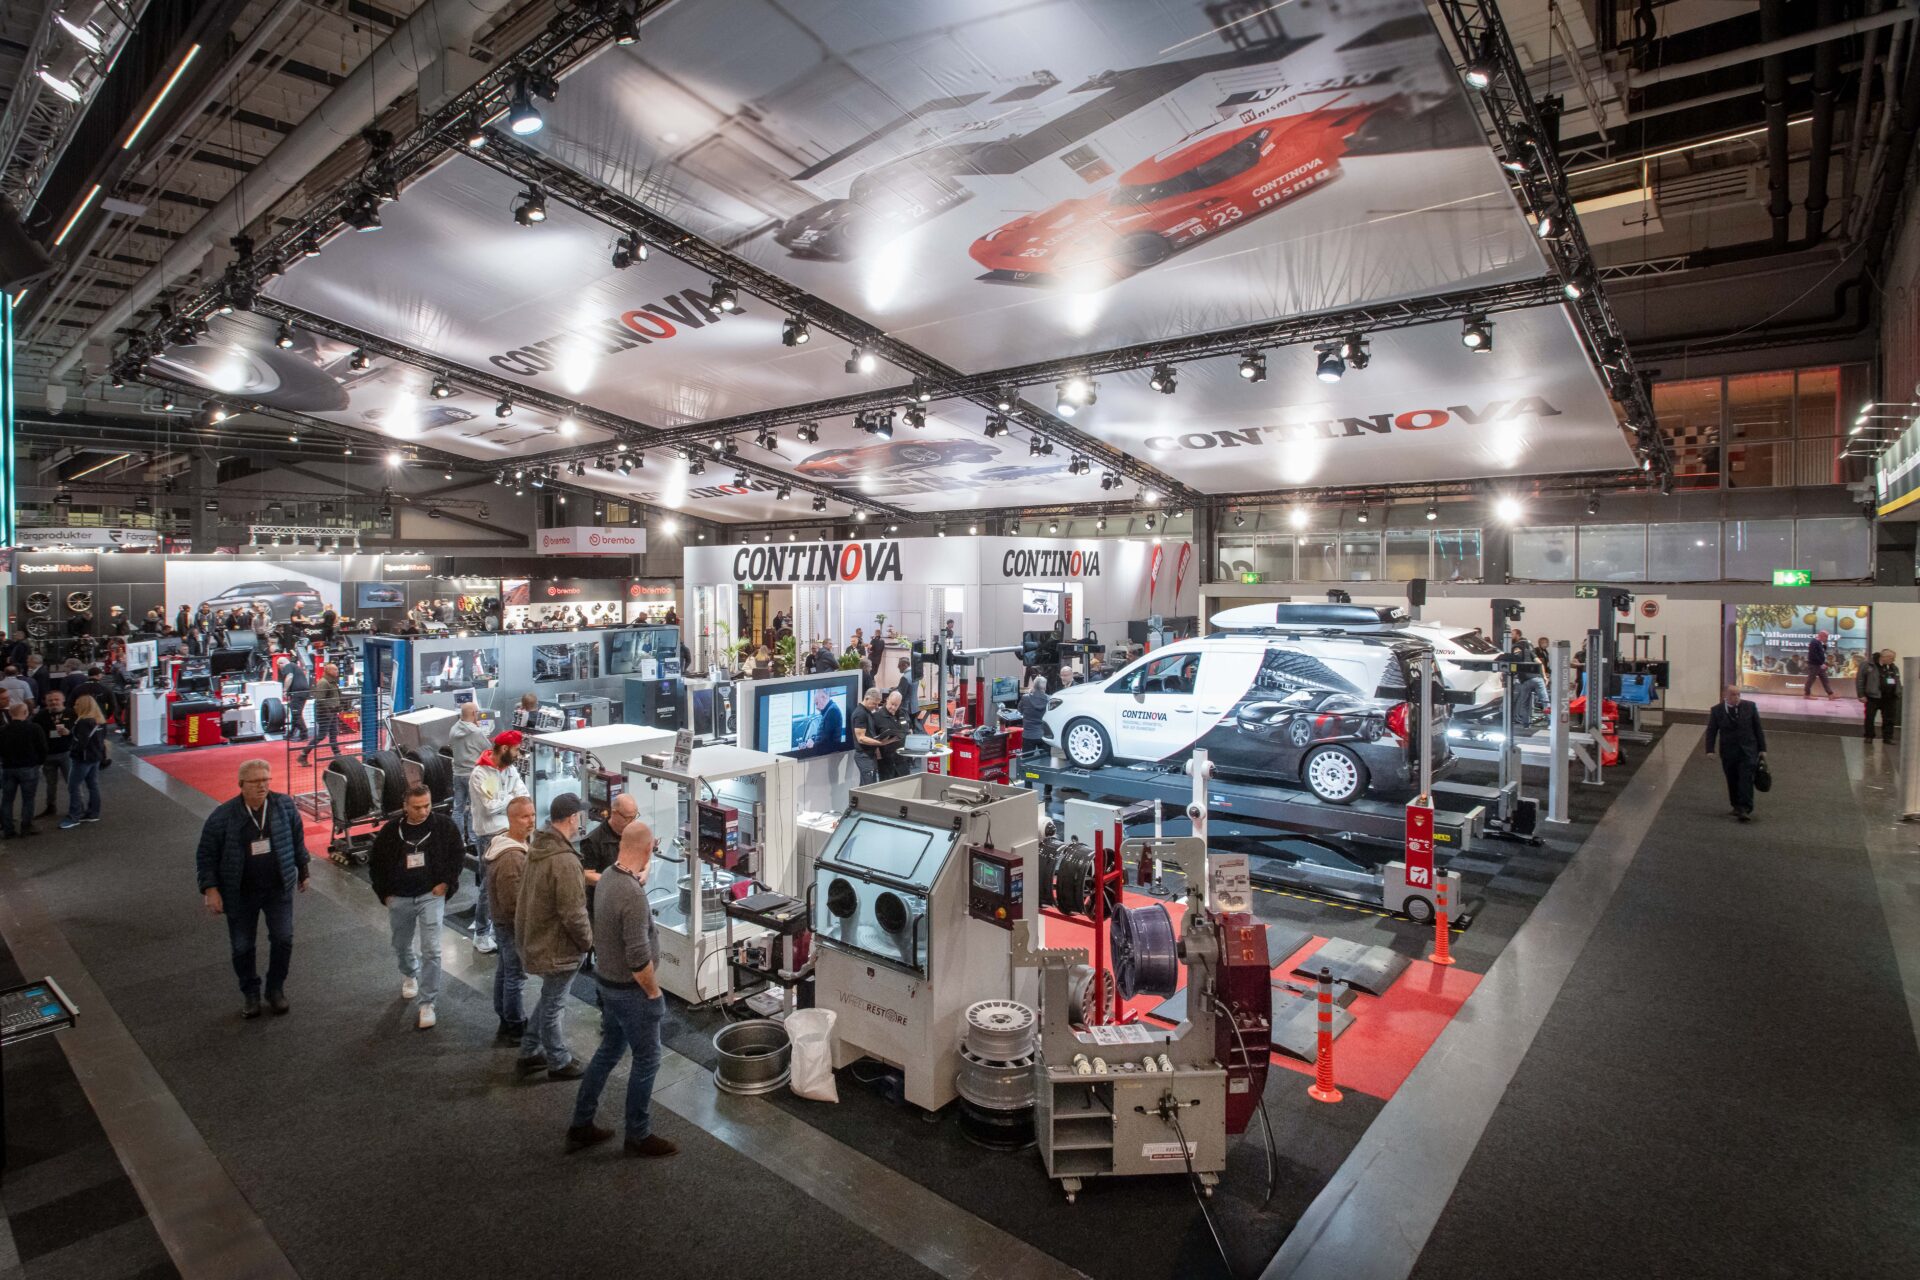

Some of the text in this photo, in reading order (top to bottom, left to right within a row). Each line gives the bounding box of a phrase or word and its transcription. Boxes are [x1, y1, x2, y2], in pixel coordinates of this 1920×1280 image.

[1252, 158, 1324, 198] CONTINOVA
[1213, 206, 1243, 226] 23
[550, 536, 571, 545] brembo
[602, 536, 635, 545] brembo
[733, 542, 903, 582] CONTINOVA
[1002, 549, 1100, 577] CONTINOVA
[556, 587, 581, 595] brembo
[641, 586, 672, 594] brembo
[1122, 709, 1168, 721] CONTINOVA
